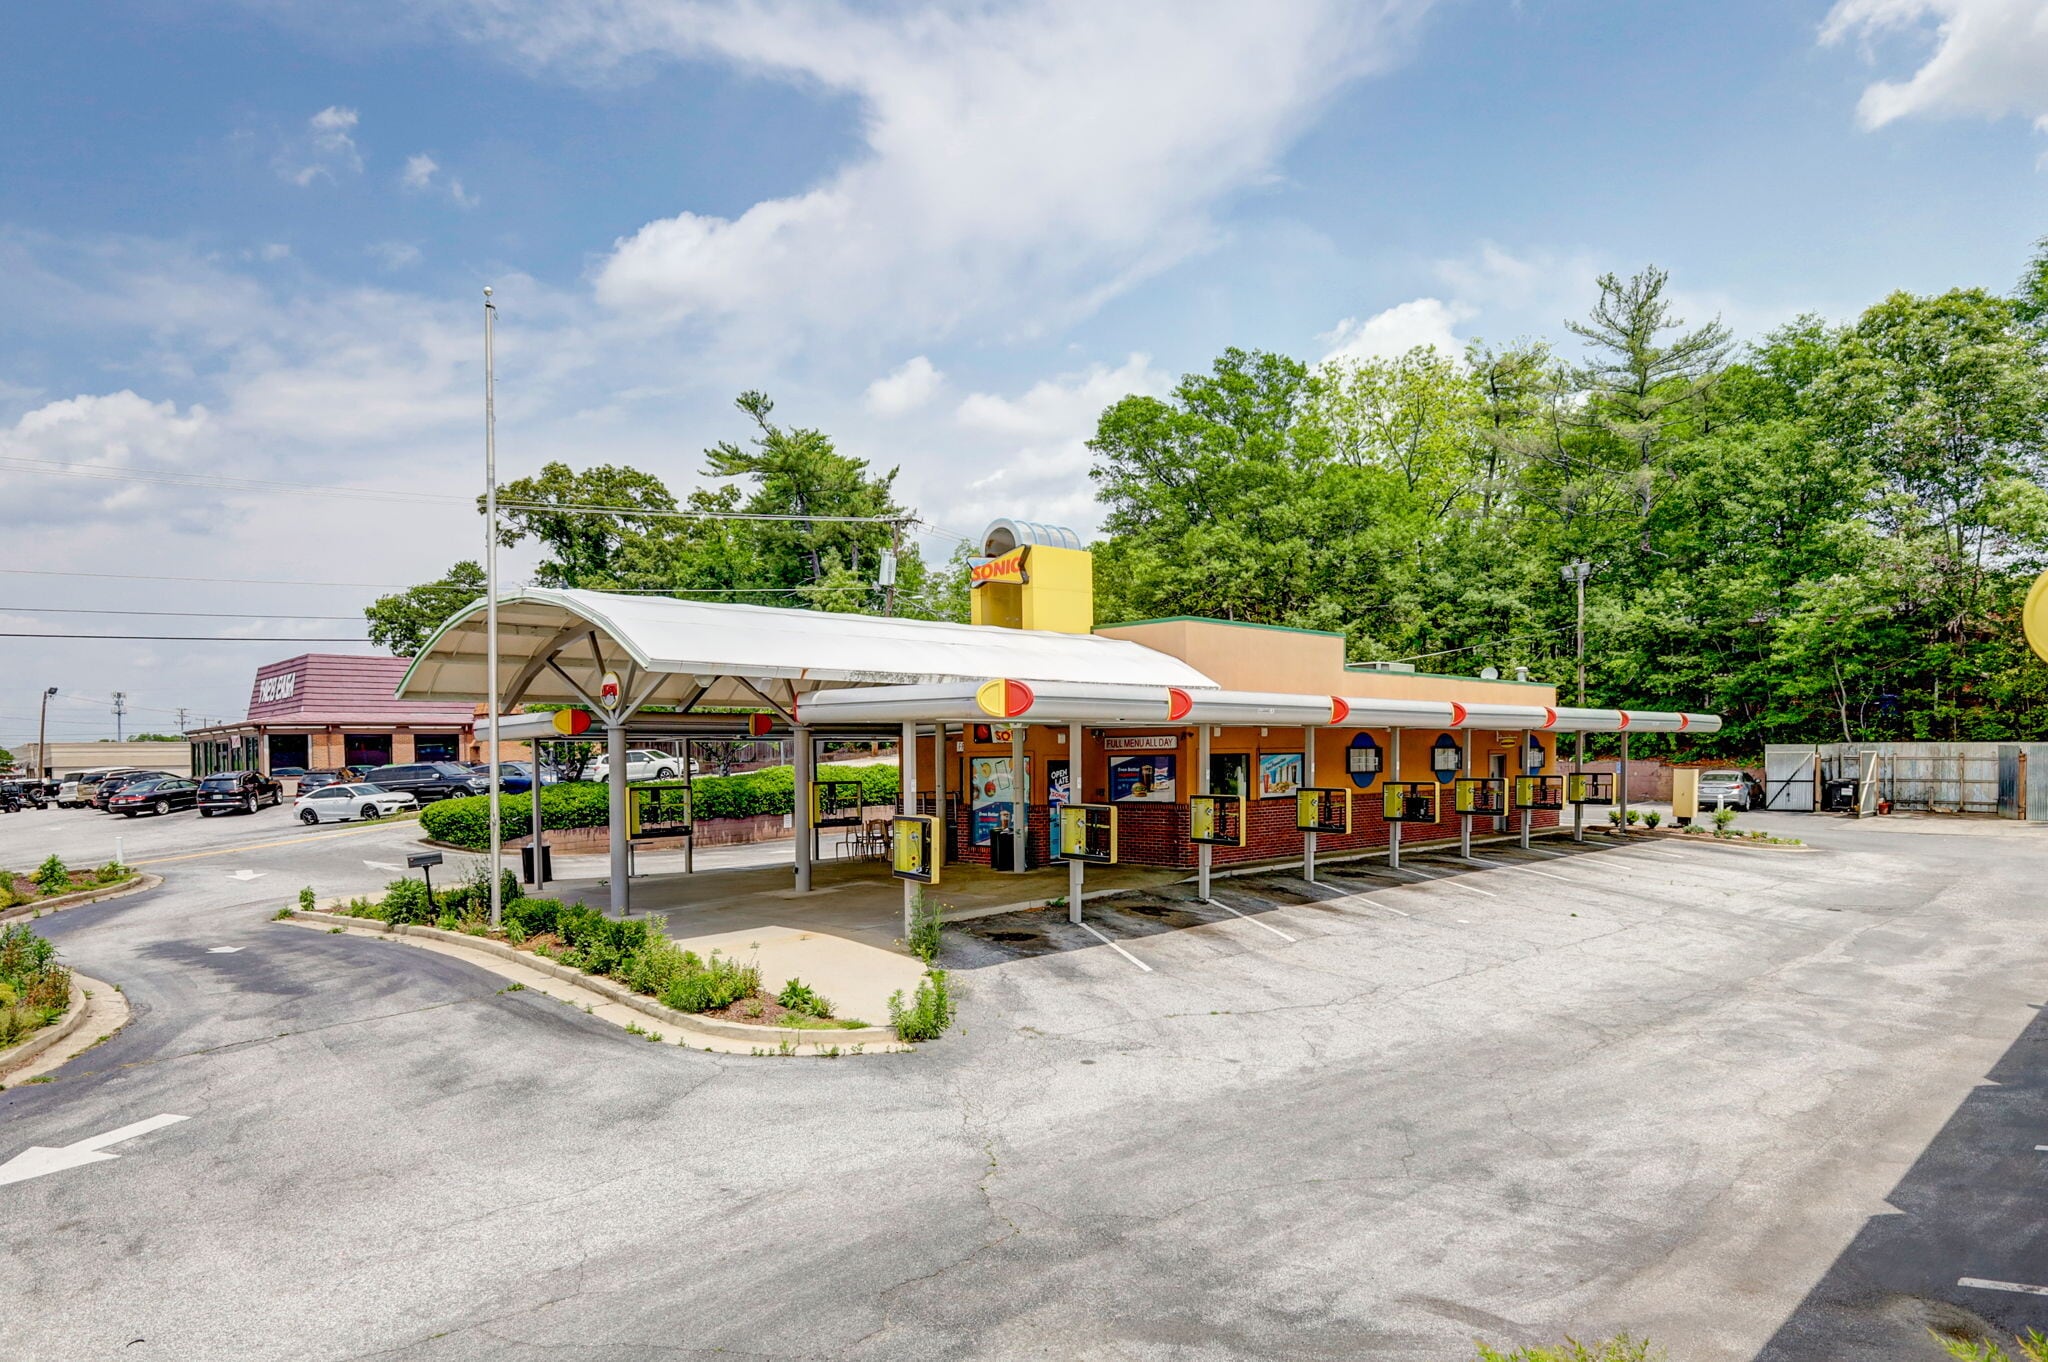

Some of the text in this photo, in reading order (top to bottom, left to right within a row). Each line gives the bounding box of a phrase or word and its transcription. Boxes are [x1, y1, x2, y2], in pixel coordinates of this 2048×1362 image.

[971, 557, 1023, 581] SONIC
[1107, 737, 1173, 748] FULL MENU ALL DAY
[1051, 769, 1068, 779] OPEN
[1055, 776, 1069, 786] LATE
